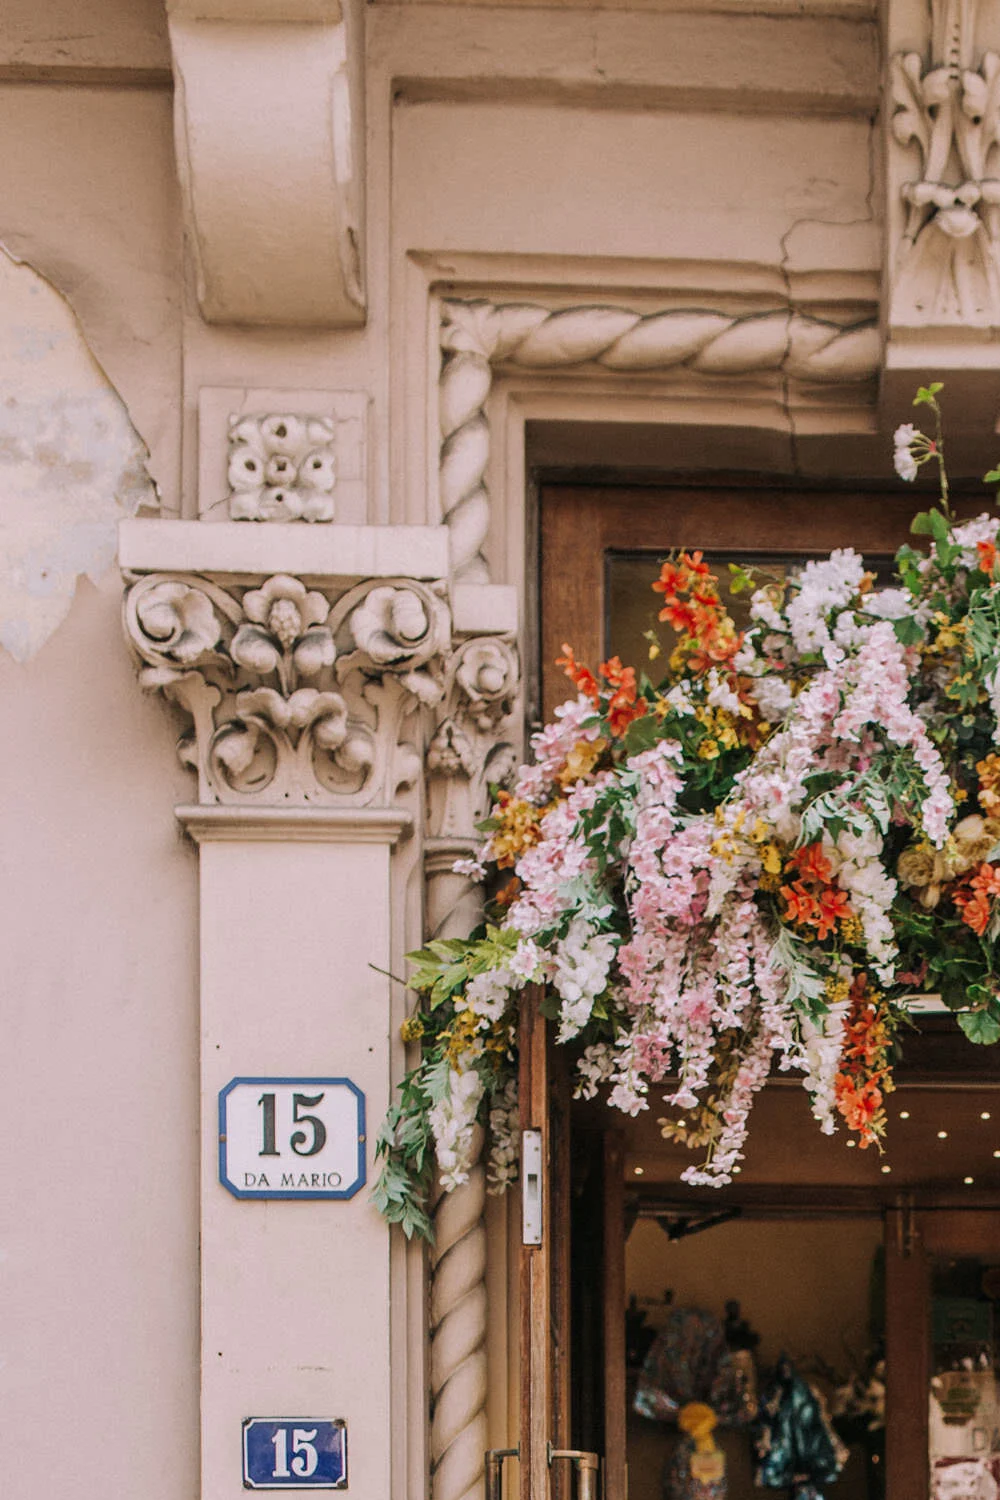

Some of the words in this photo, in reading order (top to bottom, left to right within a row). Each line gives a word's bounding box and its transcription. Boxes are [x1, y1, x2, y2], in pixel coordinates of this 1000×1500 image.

[257, 1092, 327, 1157] 15
[244, 1172, 270, 1187] DA
[280, 1172, 342, 1187] MARIO
[271, 1428, 319, 1478] 15
